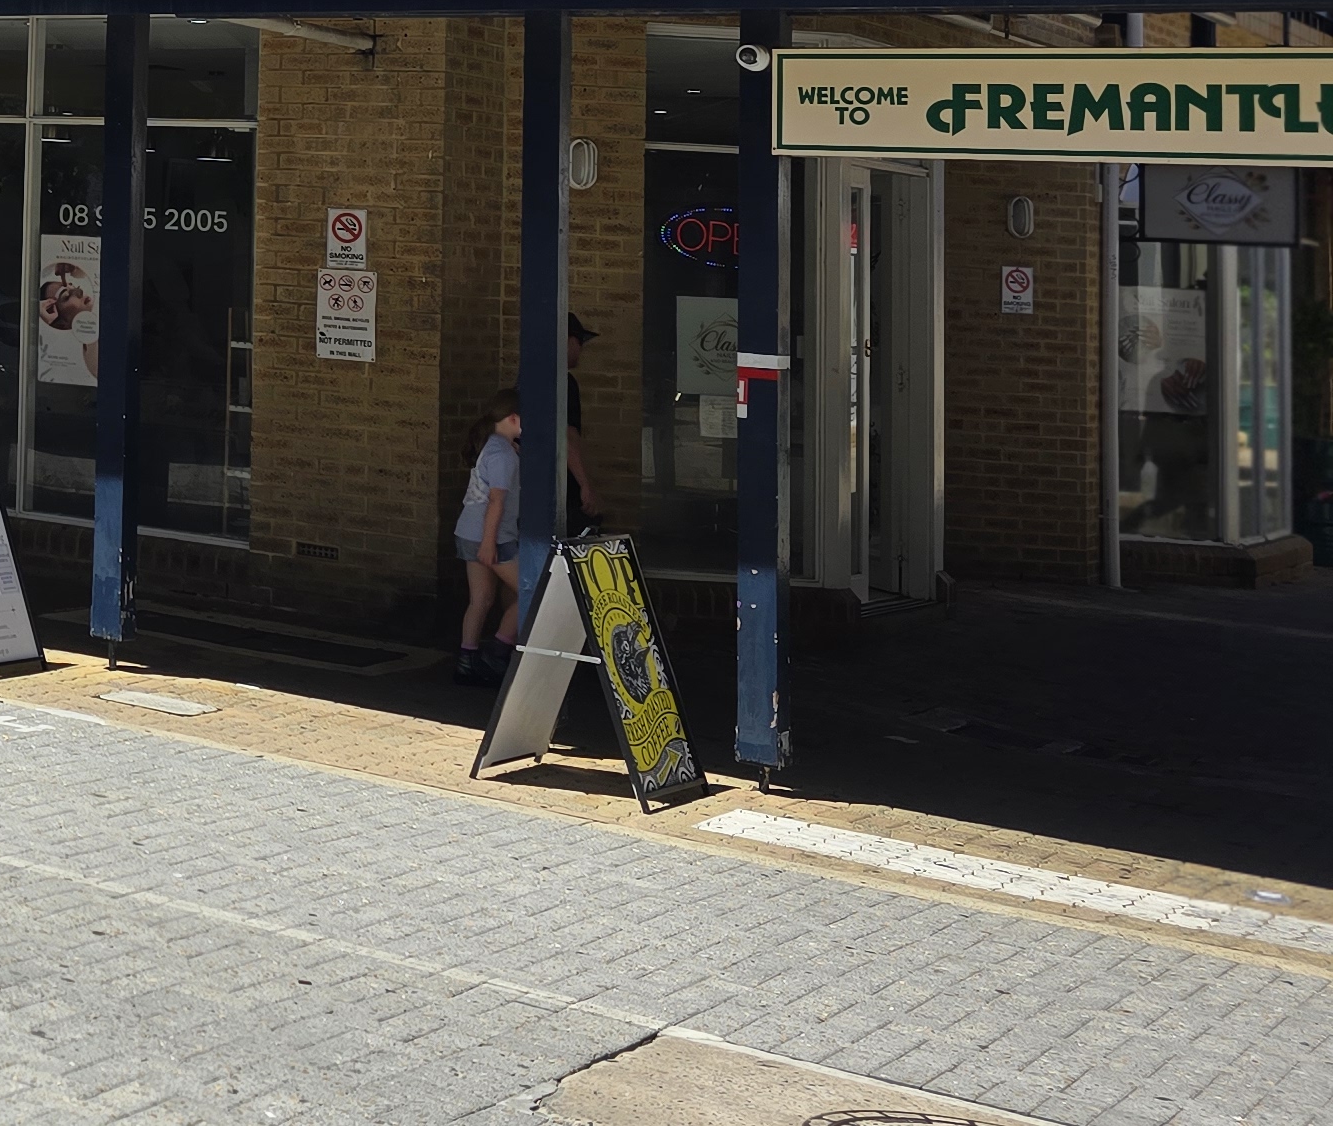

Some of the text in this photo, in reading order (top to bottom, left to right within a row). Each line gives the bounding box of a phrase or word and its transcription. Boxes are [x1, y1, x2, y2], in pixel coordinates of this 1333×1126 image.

[797, 86, 908, 105] WELCOME
[835, 106, 870, 126] TO
[1187, 181, 1253, 211] Classy
[59, 204, 88, 226] 08
[164, 208, 228, 233] 2005
[62, 240, 84, 253] Nail
[329, 252, 364, 260] SMOKING
[319, 336, 372, 347] NOT PERMITTED
[700, 330, 737, 351] Clas
[642, 716, 673, 766] COFFEE
